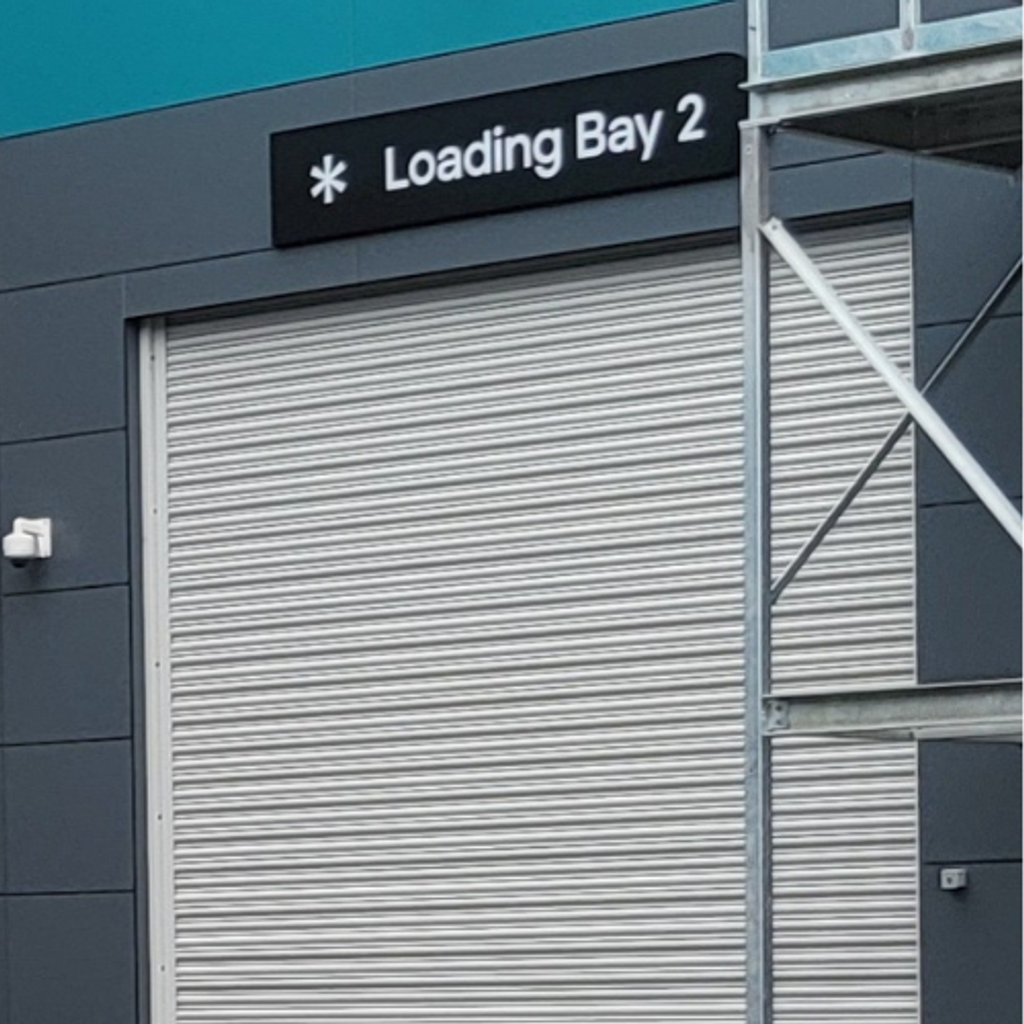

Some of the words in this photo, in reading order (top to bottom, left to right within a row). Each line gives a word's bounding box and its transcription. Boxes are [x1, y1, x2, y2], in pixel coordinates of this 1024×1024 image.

[384, 125, 563, 191] Loading
[576, 109, 664, 162] Bay
[677, 92, 706, 142] 2
